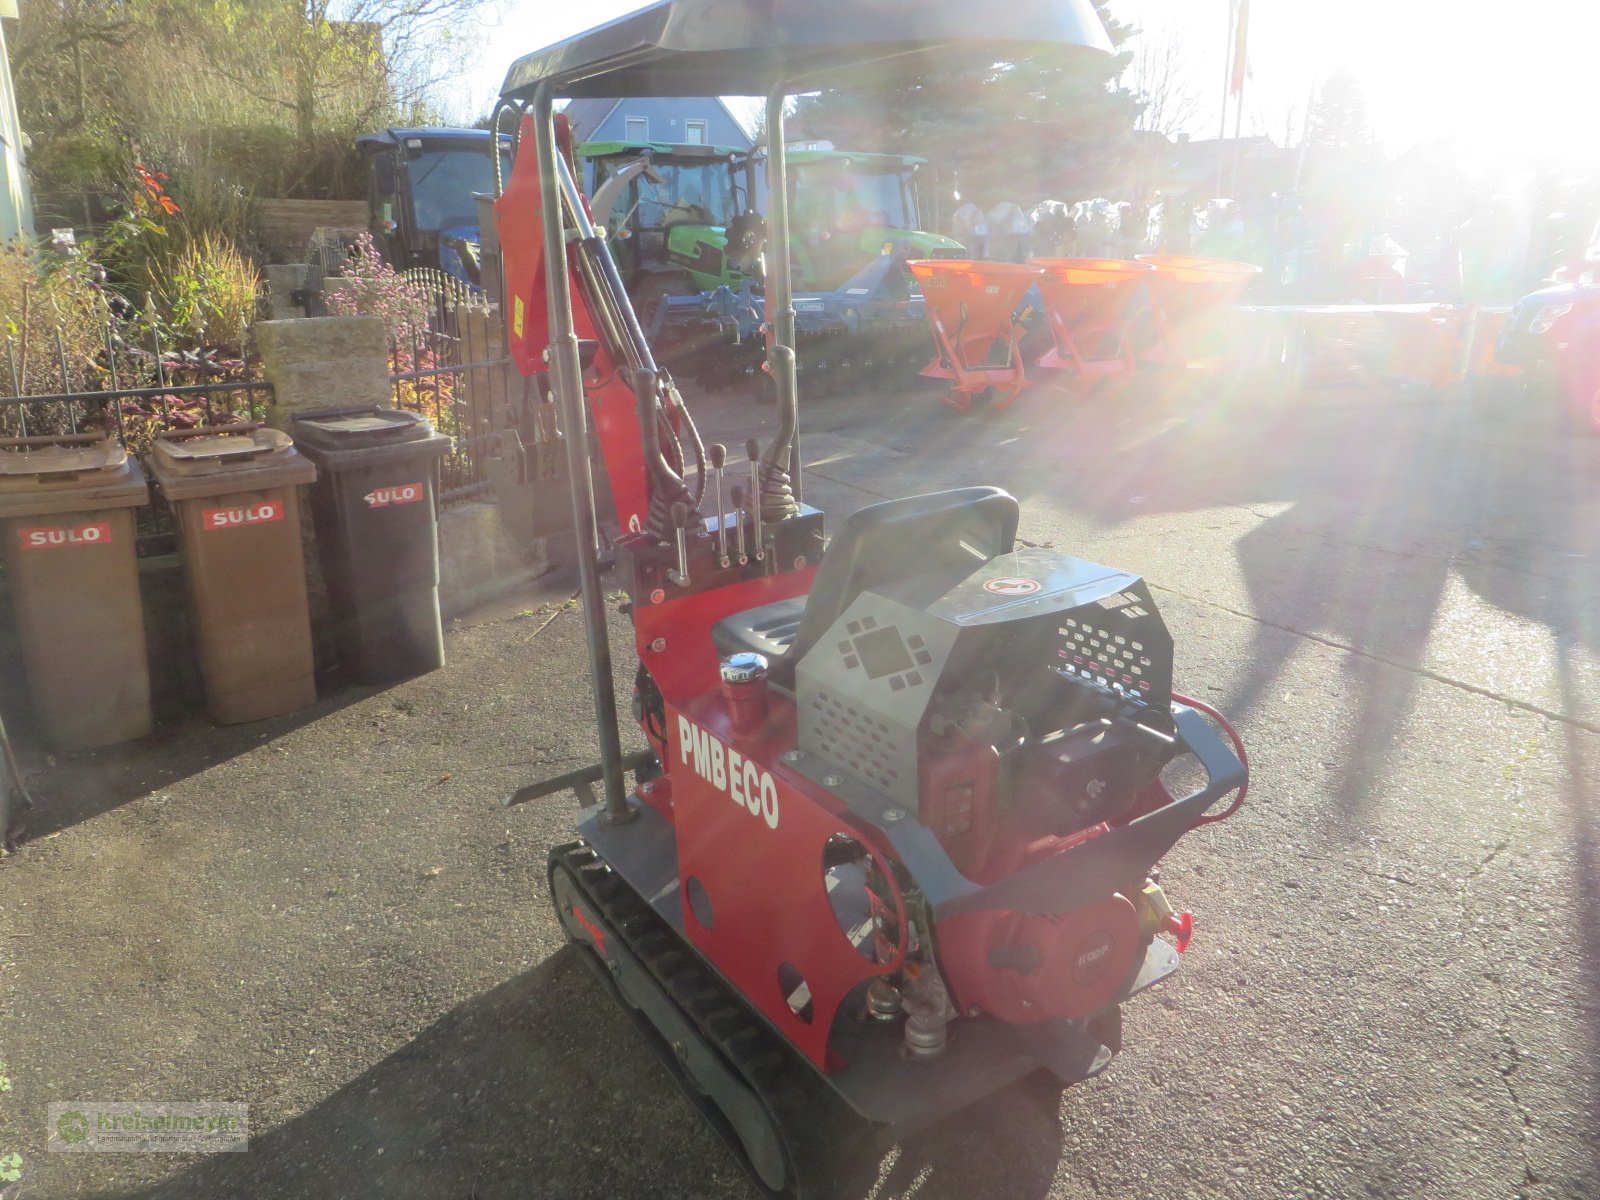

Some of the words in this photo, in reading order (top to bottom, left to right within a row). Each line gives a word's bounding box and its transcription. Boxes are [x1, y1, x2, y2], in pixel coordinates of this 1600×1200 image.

[363, 487, 415, 504] SULO
[212, 505, 274, 526] SULO
[30, 527, 100, 545] SULO
[678, 714, 727, 792] PMB
[728, 747, 779, 830] ECO
